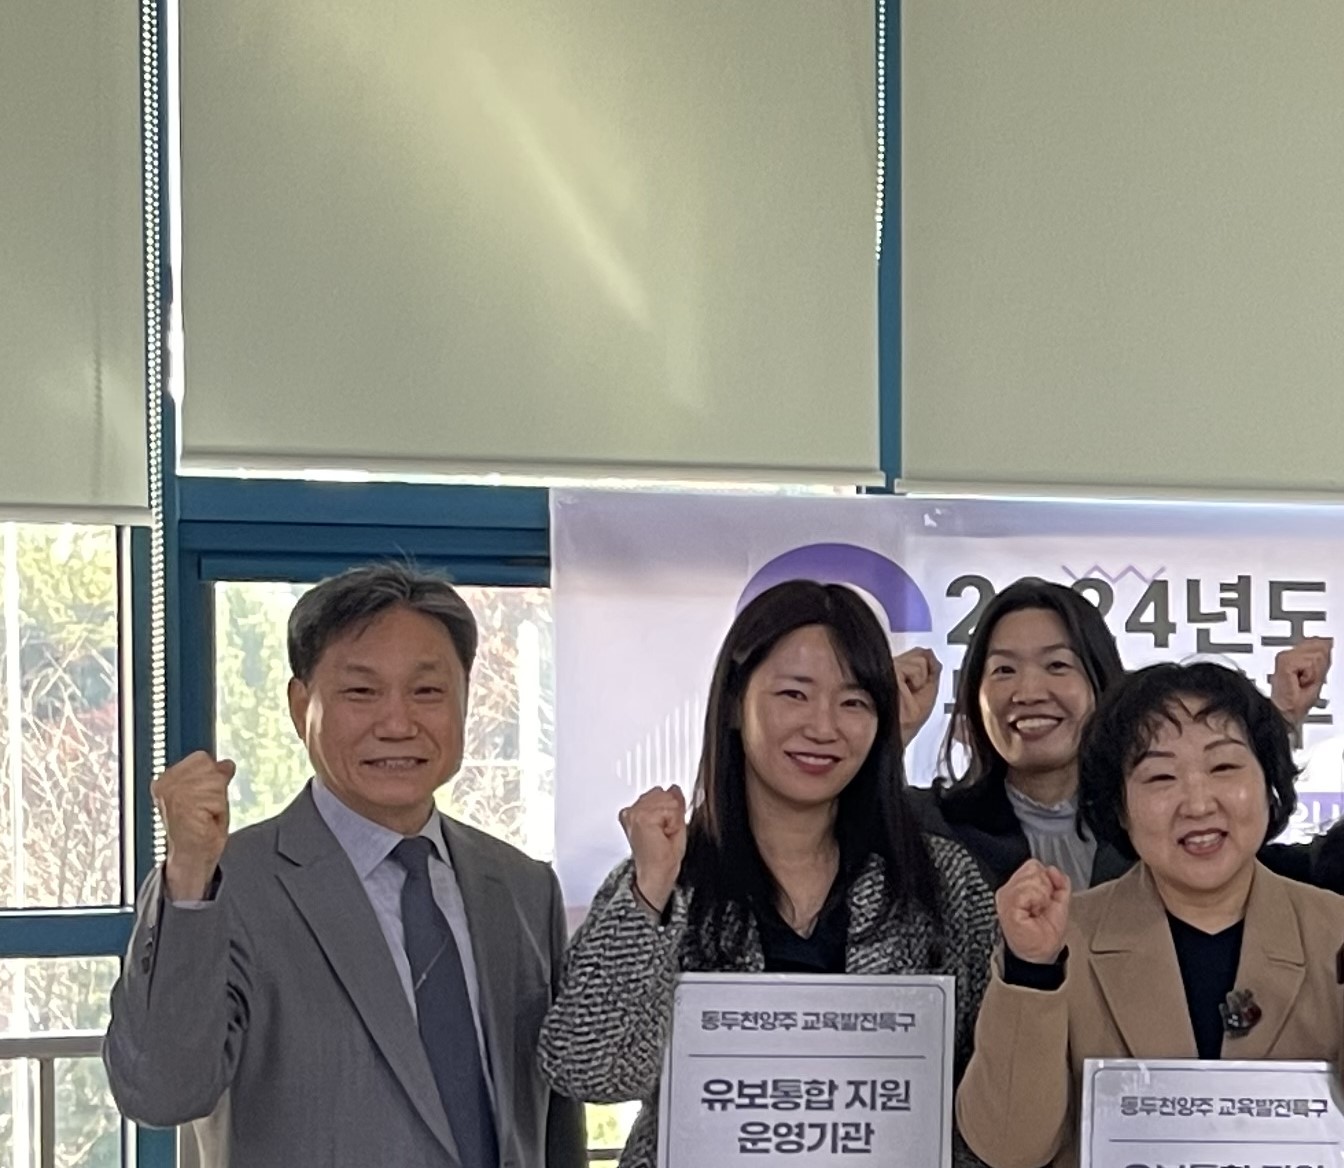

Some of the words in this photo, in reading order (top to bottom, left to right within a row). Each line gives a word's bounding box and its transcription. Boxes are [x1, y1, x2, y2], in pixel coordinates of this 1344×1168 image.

[701, 1010, 797, 1031] 동두천양주
[802, 1012, 916, 1032] 교육발전특구
[701, 1078, 839, 1111] 유보통합
[844, 1079, 911, 1111] 지원
[1120, 1096, 1214, 1117] 동두천양주
[1219, 1098, 1328, 1118] 교육발전특구
[738, 1121, 874, 1154] 운영기관
